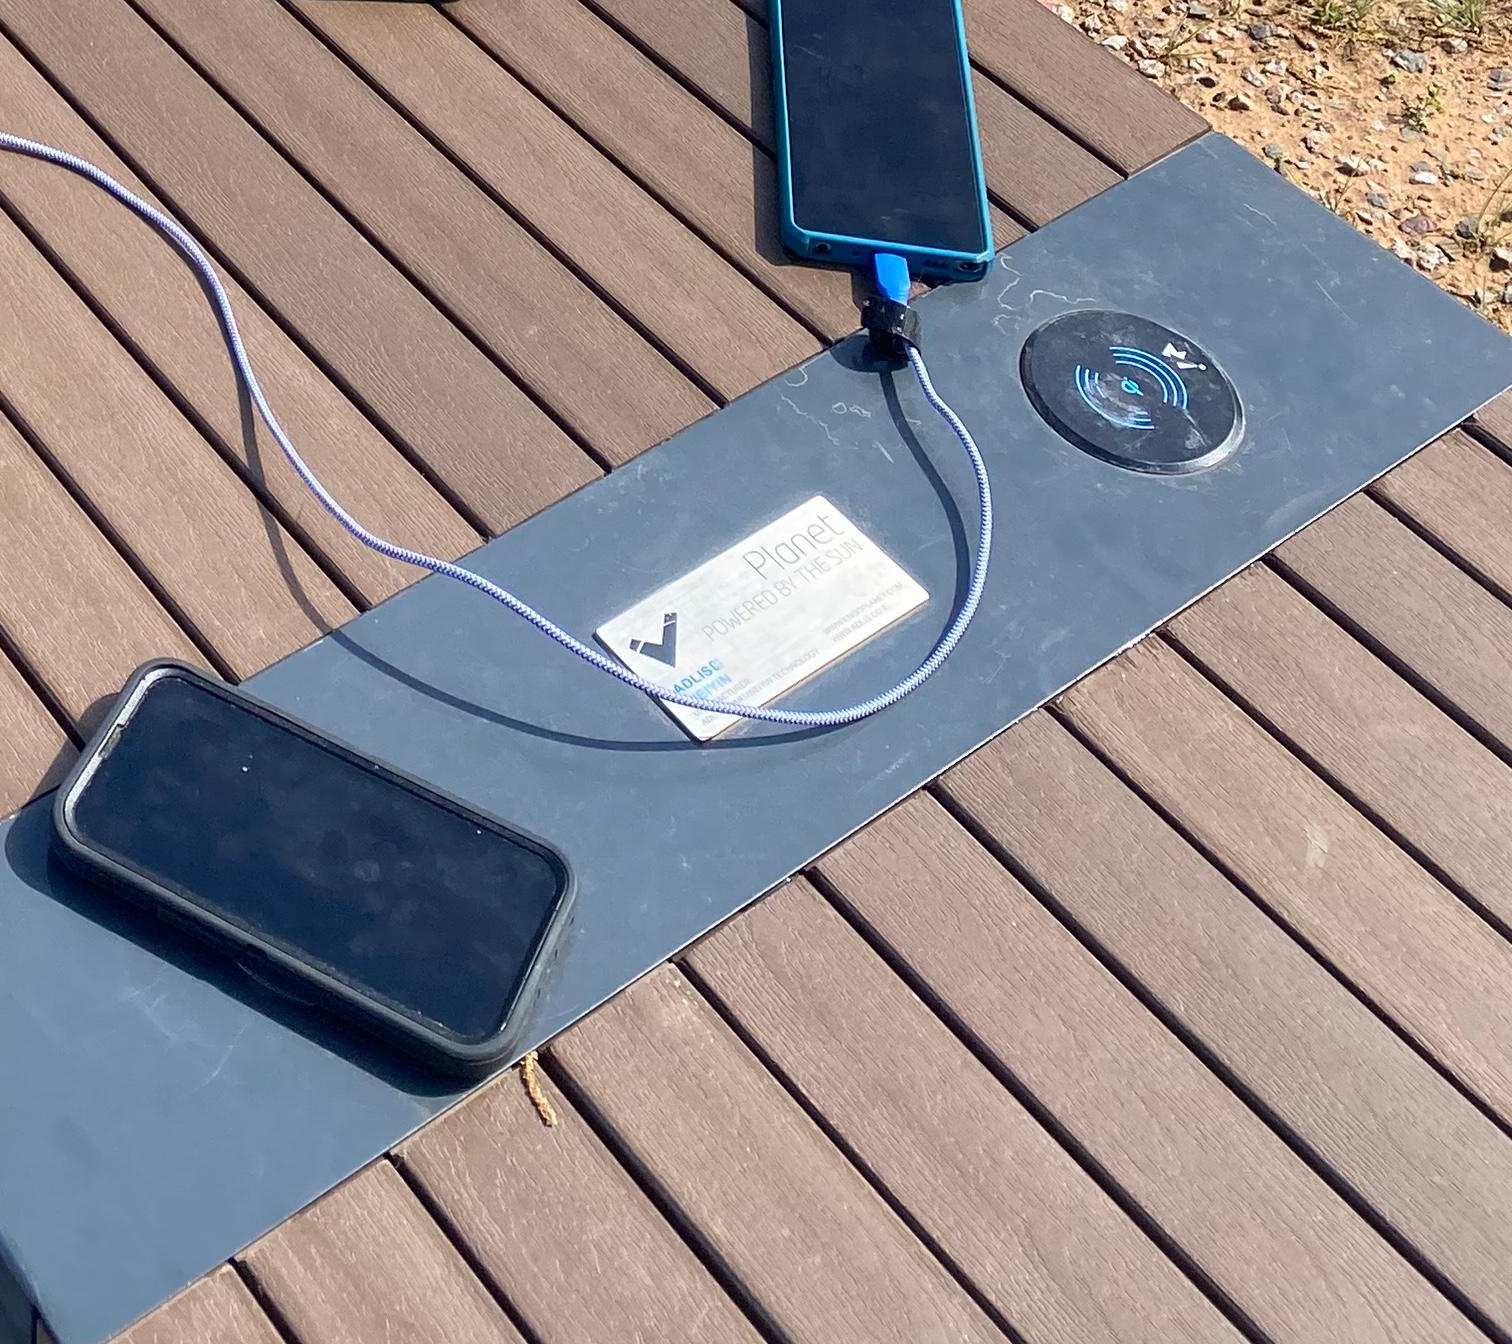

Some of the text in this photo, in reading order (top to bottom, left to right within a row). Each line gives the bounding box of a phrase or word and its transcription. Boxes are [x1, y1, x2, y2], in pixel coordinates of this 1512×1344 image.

[742, 514, 846, 581] Planet
[701, 537, 864, 642] POWERED BY THE SUN
[693, 672, 733, 701] EIYIN
